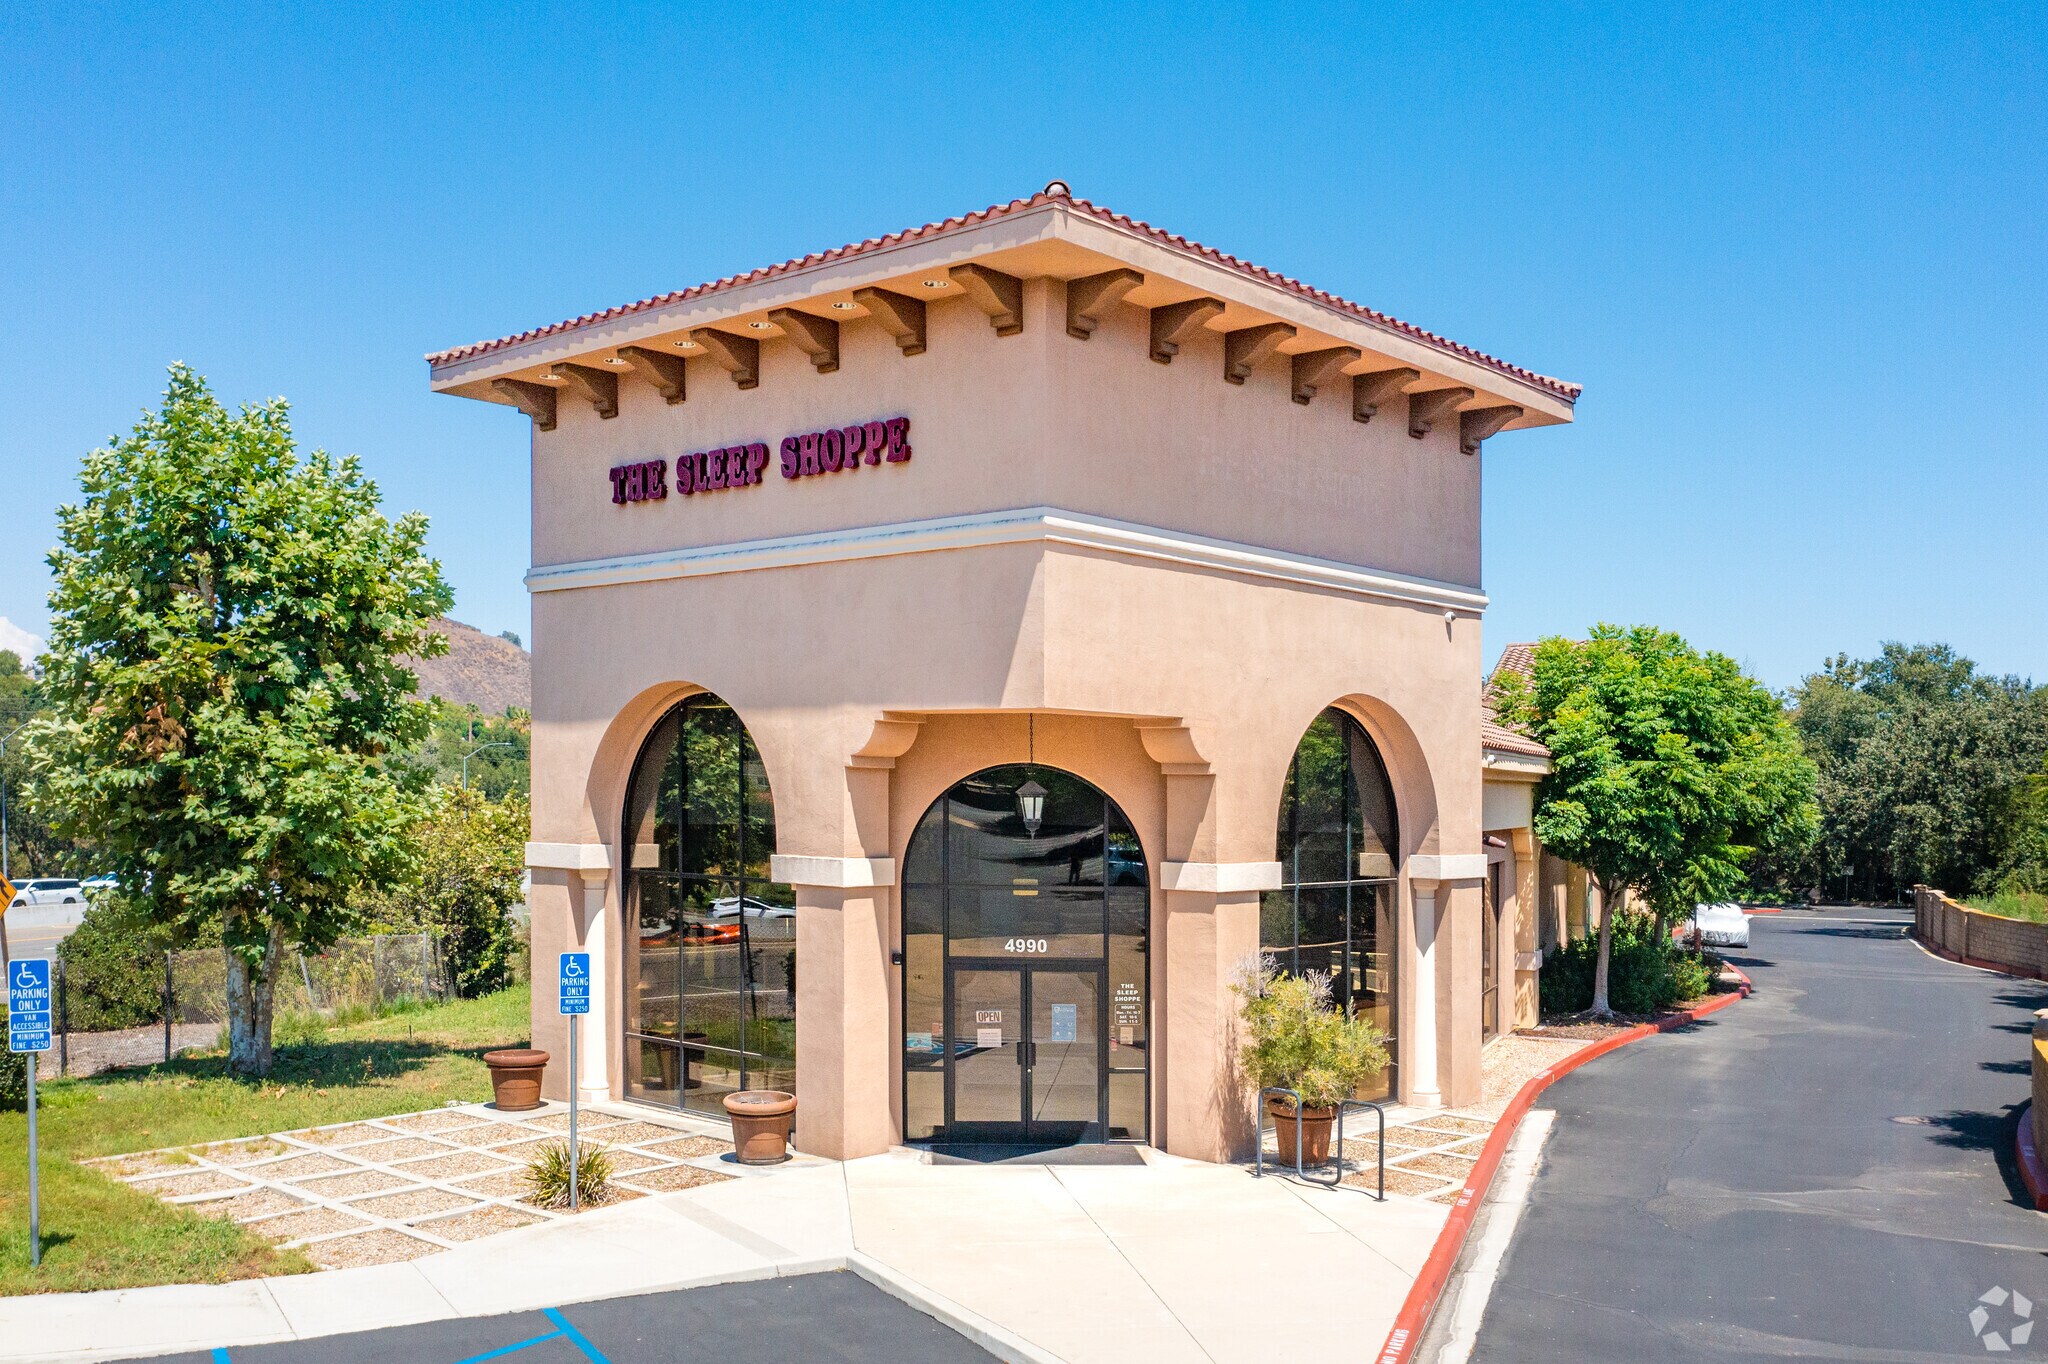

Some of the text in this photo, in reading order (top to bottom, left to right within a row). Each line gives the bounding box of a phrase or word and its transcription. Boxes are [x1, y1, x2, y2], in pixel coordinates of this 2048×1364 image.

[609, 416, 913, 504] THE SLEEP SHOPPE
[1004, 938, 1048, 953] 4990
[561, 976, 589, 986] PARKING
[11, 987, 48, 999] PARKING
[566, 987, 584, 996] ONLY
[18, 999, 41, 1011] ONLY
[978, 1011, 1000, 1022] OPEN
[12, 1021, 48, 1030] ACCESSIBLE
[16, 1032, 45, 1040] MINIMUM
[12, 1040, 49, 1049] FINE $250
[1385, 1328, 1410, 1355] PARKING
